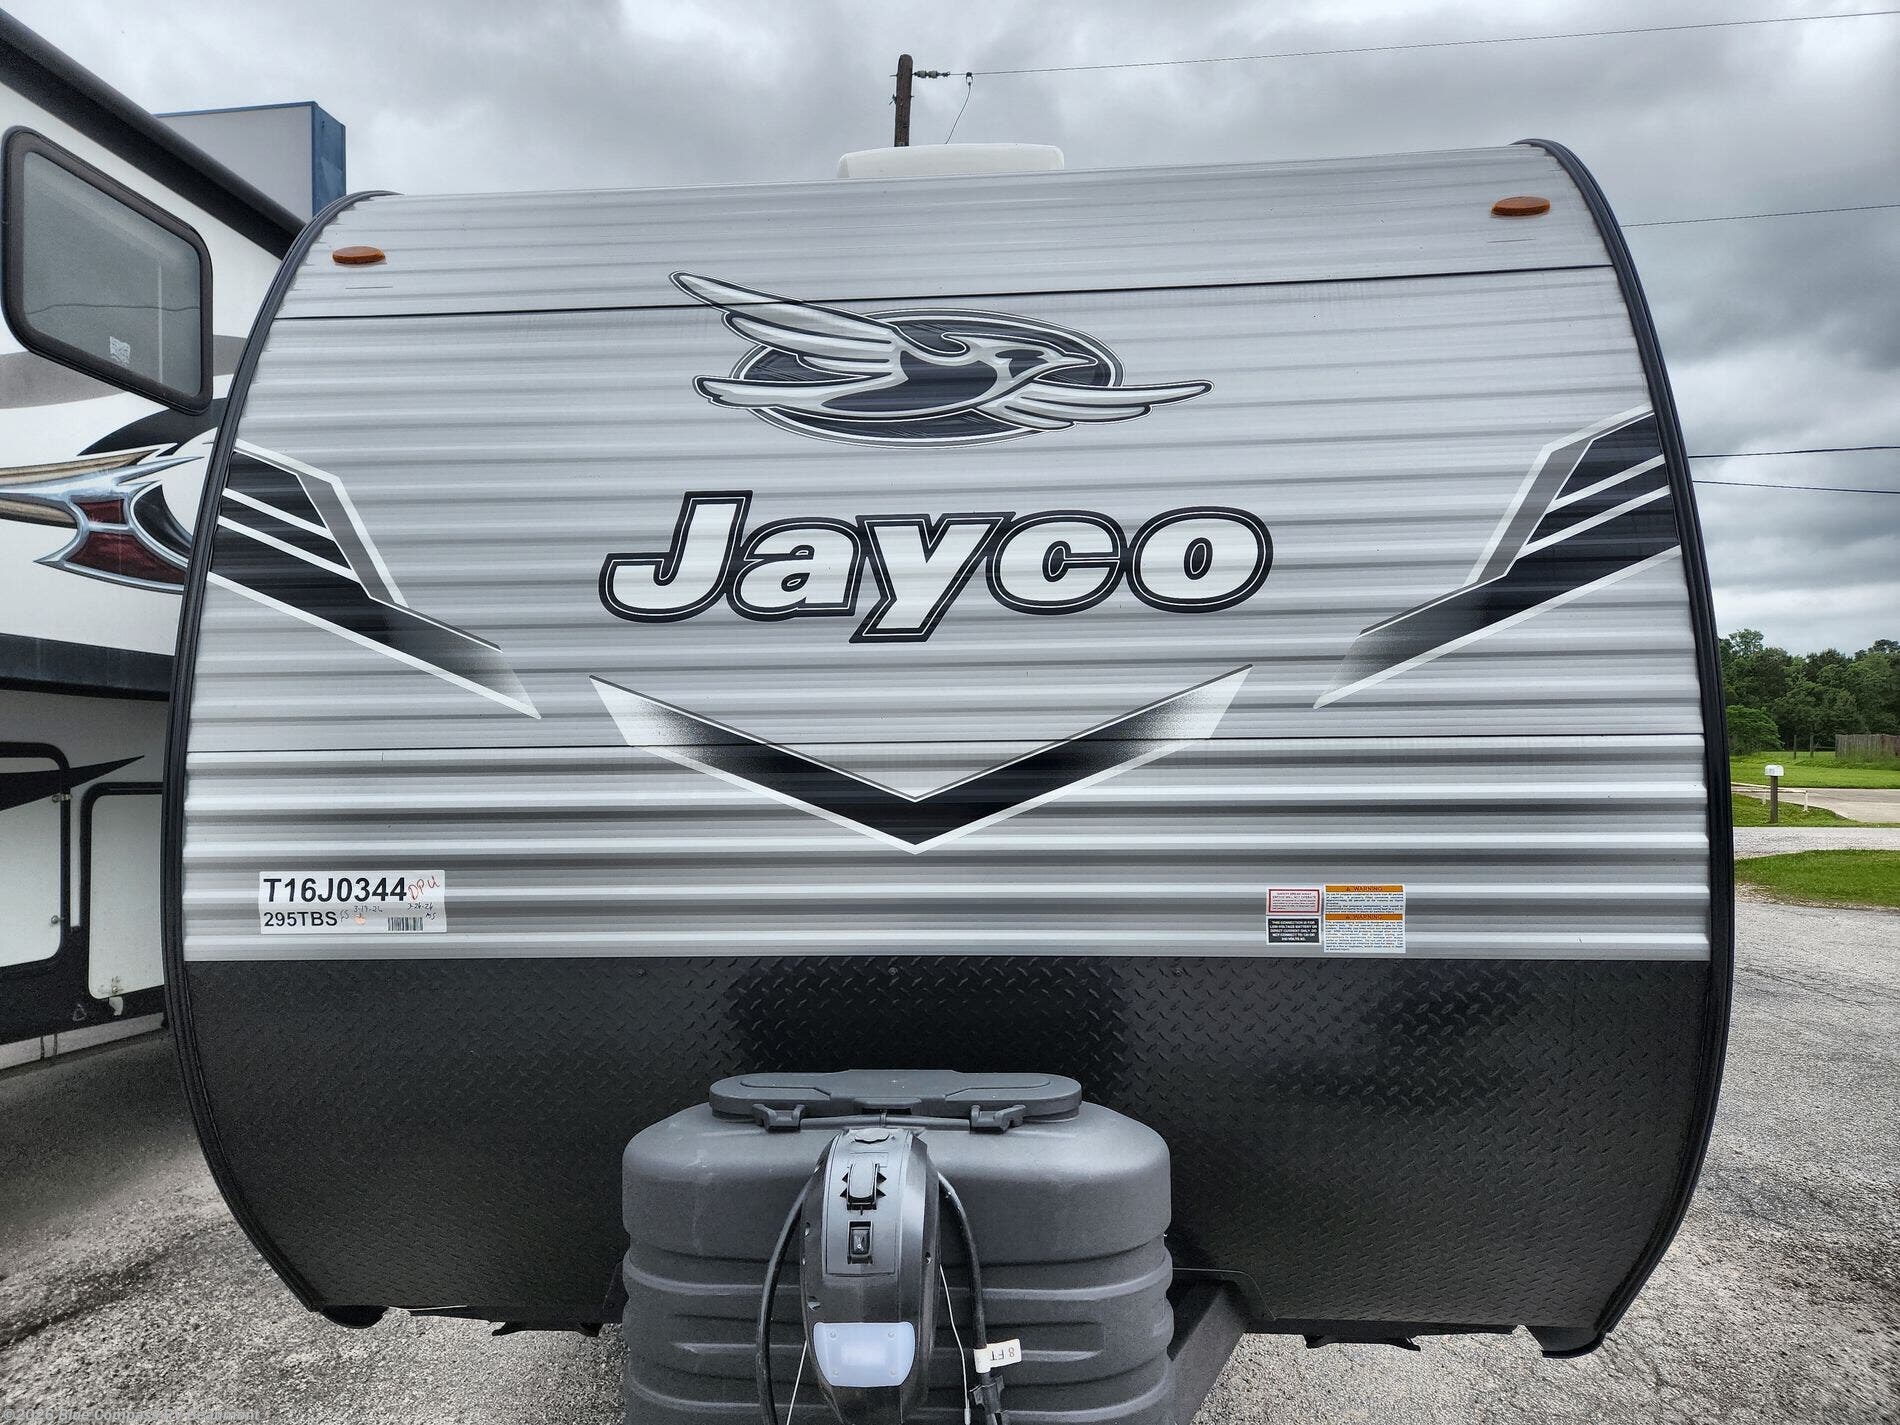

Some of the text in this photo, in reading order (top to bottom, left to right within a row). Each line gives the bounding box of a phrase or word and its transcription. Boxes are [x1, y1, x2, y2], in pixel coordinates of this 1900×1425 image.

[598, 490, 1273, 643] Jayco
[263, 877, 407, 902] T16J0344
[263, 911, 338, 927] 295TBS
[990, 1346, 1015, 1360] 8 FT
